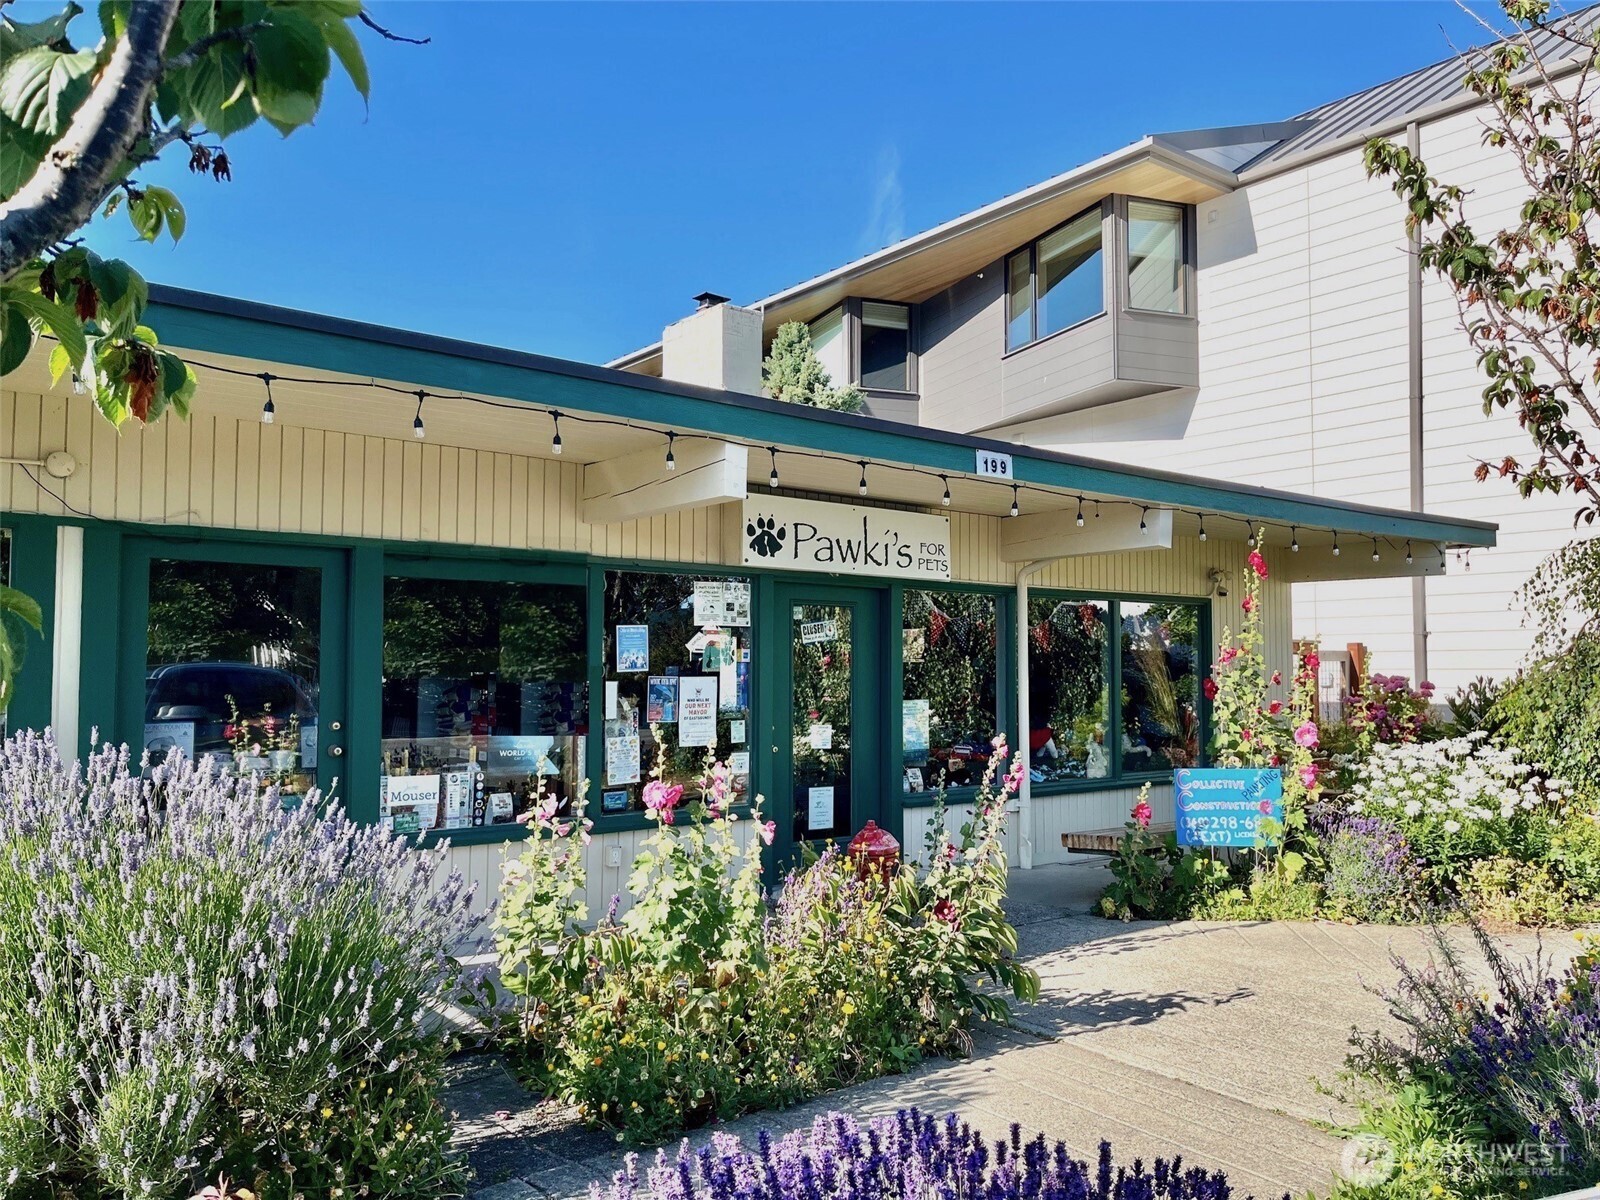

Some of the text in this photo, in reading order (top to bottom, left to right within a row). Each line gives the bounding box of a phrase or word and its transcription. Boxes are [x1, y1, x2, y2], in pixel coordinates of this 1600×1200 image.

[984, 458, 1006, 474] 199
[793, 515, 913, 568] Pawki's
[920, 542, 946, 556] FOR
[918, 558, 949, 572] PETS
[803, 624, 825, 636] CLOSED
[499, 748, 549, 757] WORLD'S BST
[1177, 769, 1245, 790] COLLECTIVE
[1241, 769, 1279, 801] PAINTING
[390, 791, 438, 802] Mouser
[1178, 791, 1264, 811] CONSTRUCTIO
